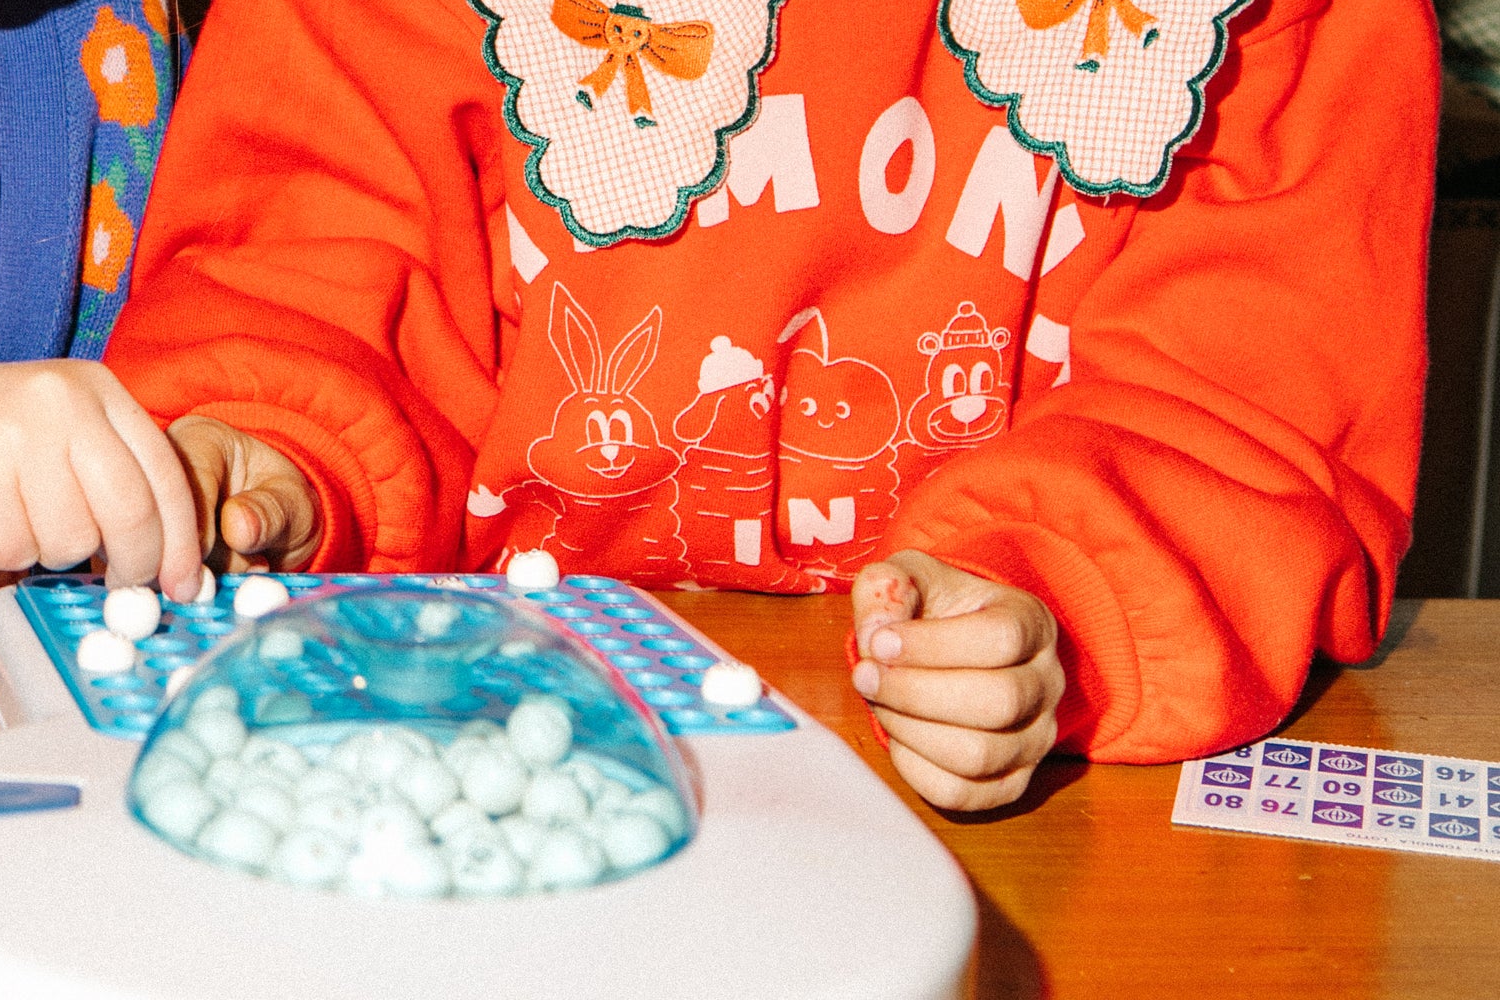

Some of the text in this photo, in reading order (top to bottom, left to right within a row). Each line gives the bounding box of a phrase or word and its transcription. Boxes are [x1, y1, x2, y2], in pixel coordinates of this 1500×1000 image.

[734, 497, 856, 566] IN
[1234, 745, 1253, 759] 8
[1264, 774, 1475, 808] 41 60 77
[1436, 766, 1476, 782] 46
[1204, 792, 1416, 829] 52 76 80
